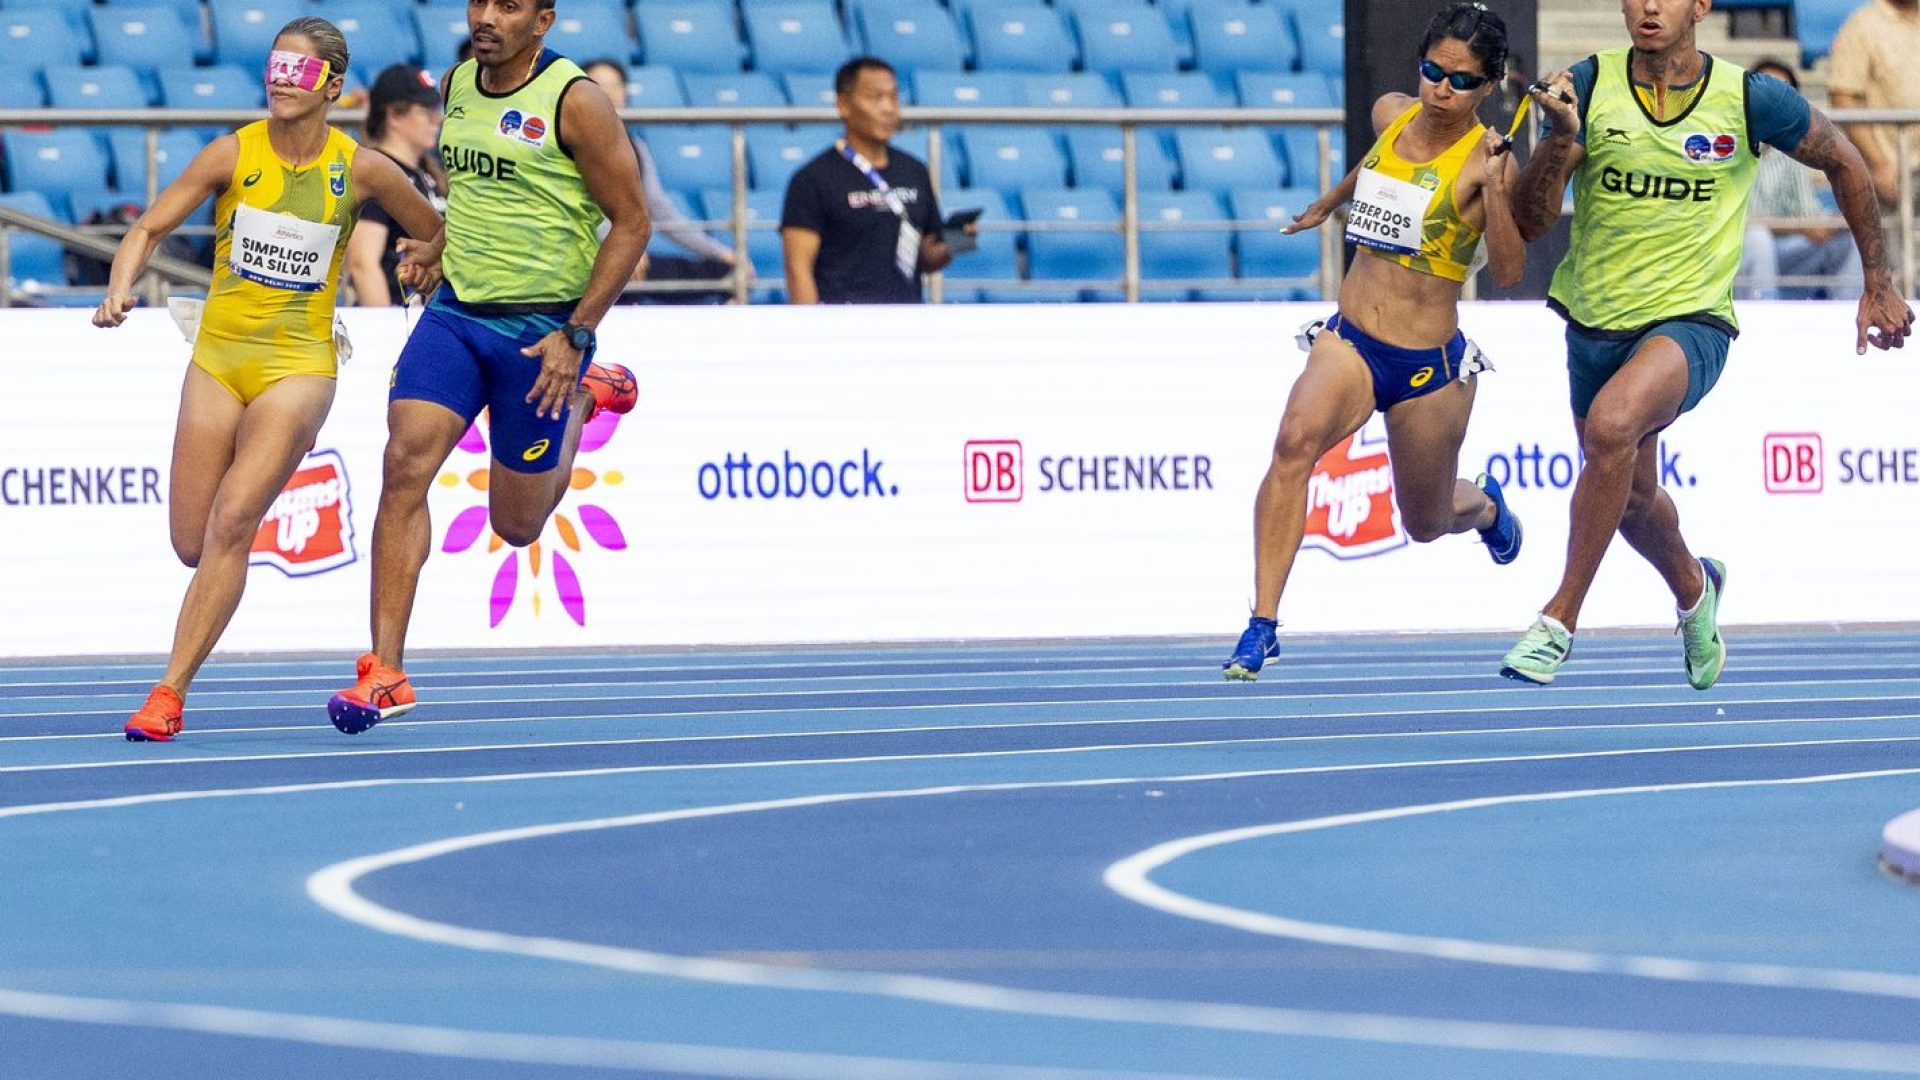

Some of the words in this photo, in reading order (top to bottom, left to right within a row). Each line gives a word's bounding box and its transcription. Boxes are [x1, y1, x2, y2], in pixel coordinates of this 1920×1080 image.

[442, 144, 516, 181] GUIDE
[1600, 165, 1715, 202] GUIDE
[1347, 213, 1400, 239] SANTOS
[1352, 200, 1382, 219] EBER
[1382, 210, 1412, 229] DOS
[242, 237, 319, 263] SIMPLICIO
[242, 251, 264, 269] DA
[267, 258, 312, 277] SILVA
[971, 451, 1016, 493] DB
[1038, 455, 1214, 492] SCHENKER
[1771, 443, 1816, 484] DB
[1838, 449, 1920, 484] SCHE
[1, 466, 163, 506] CHENKER
